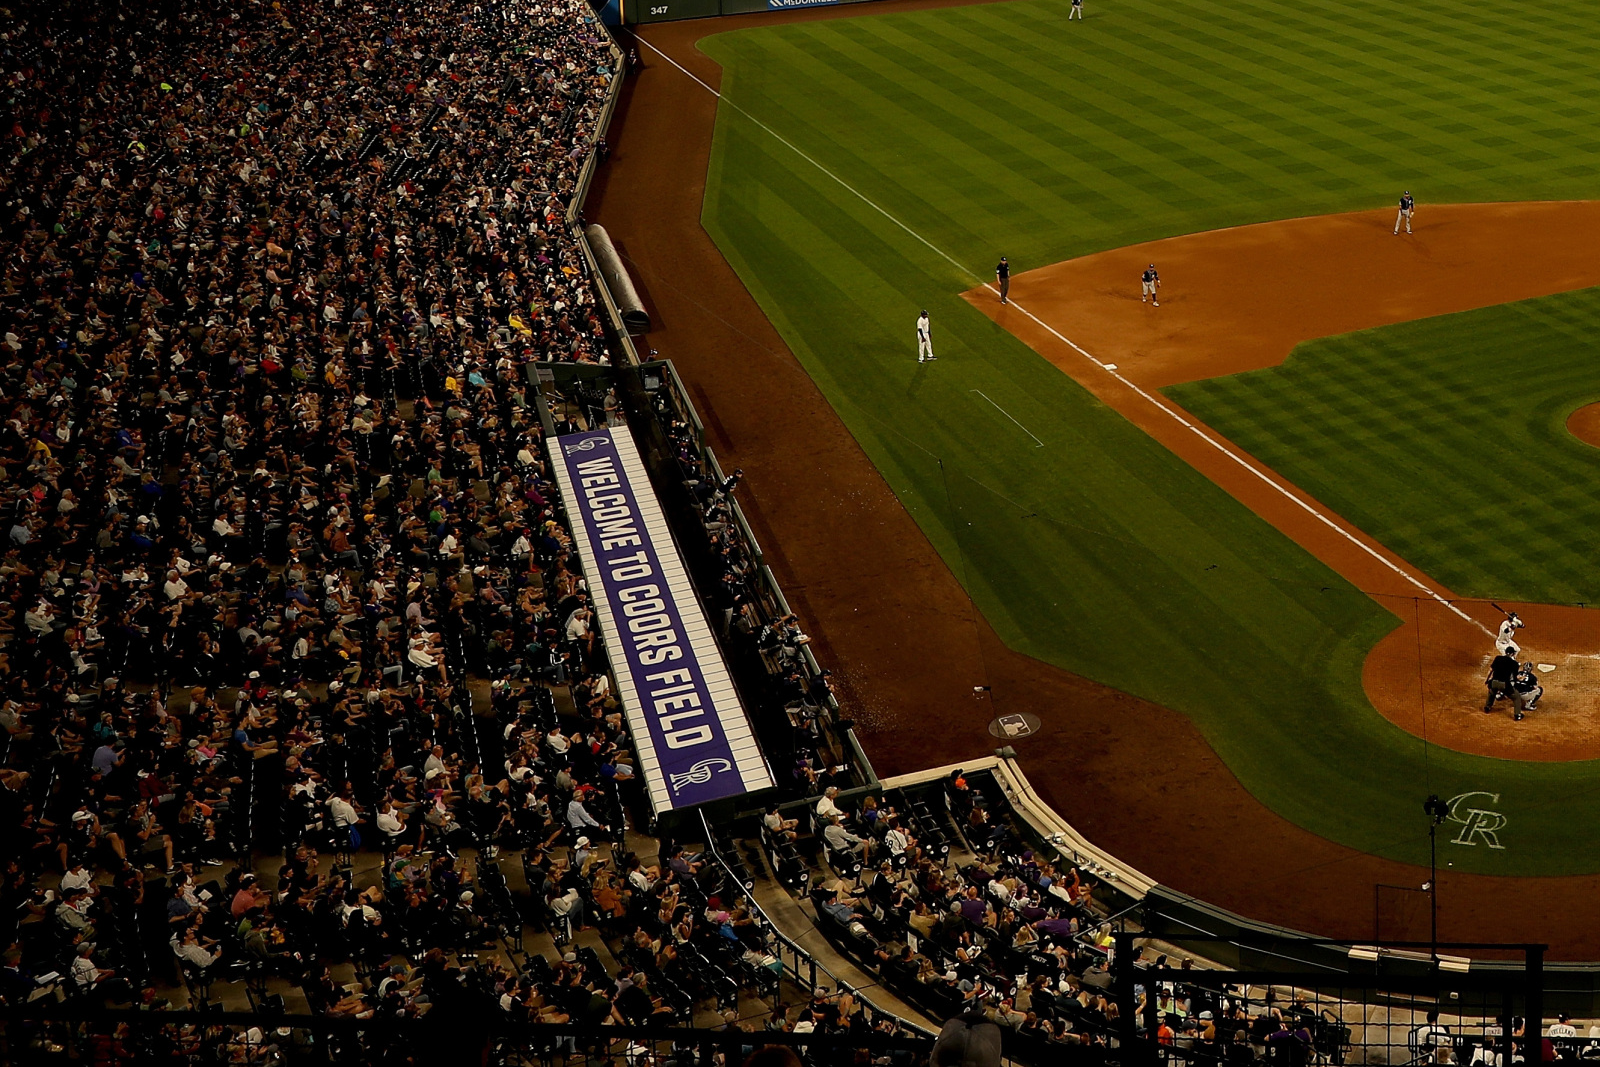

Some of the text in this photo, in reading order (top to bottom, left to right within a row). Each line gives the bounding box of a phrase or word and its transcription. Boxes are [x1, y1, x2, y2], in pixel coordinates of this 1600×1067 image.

[650, 6, 668, 15] 347
[576, 456, 713, 749] WELCOME TO COORS FIELD
